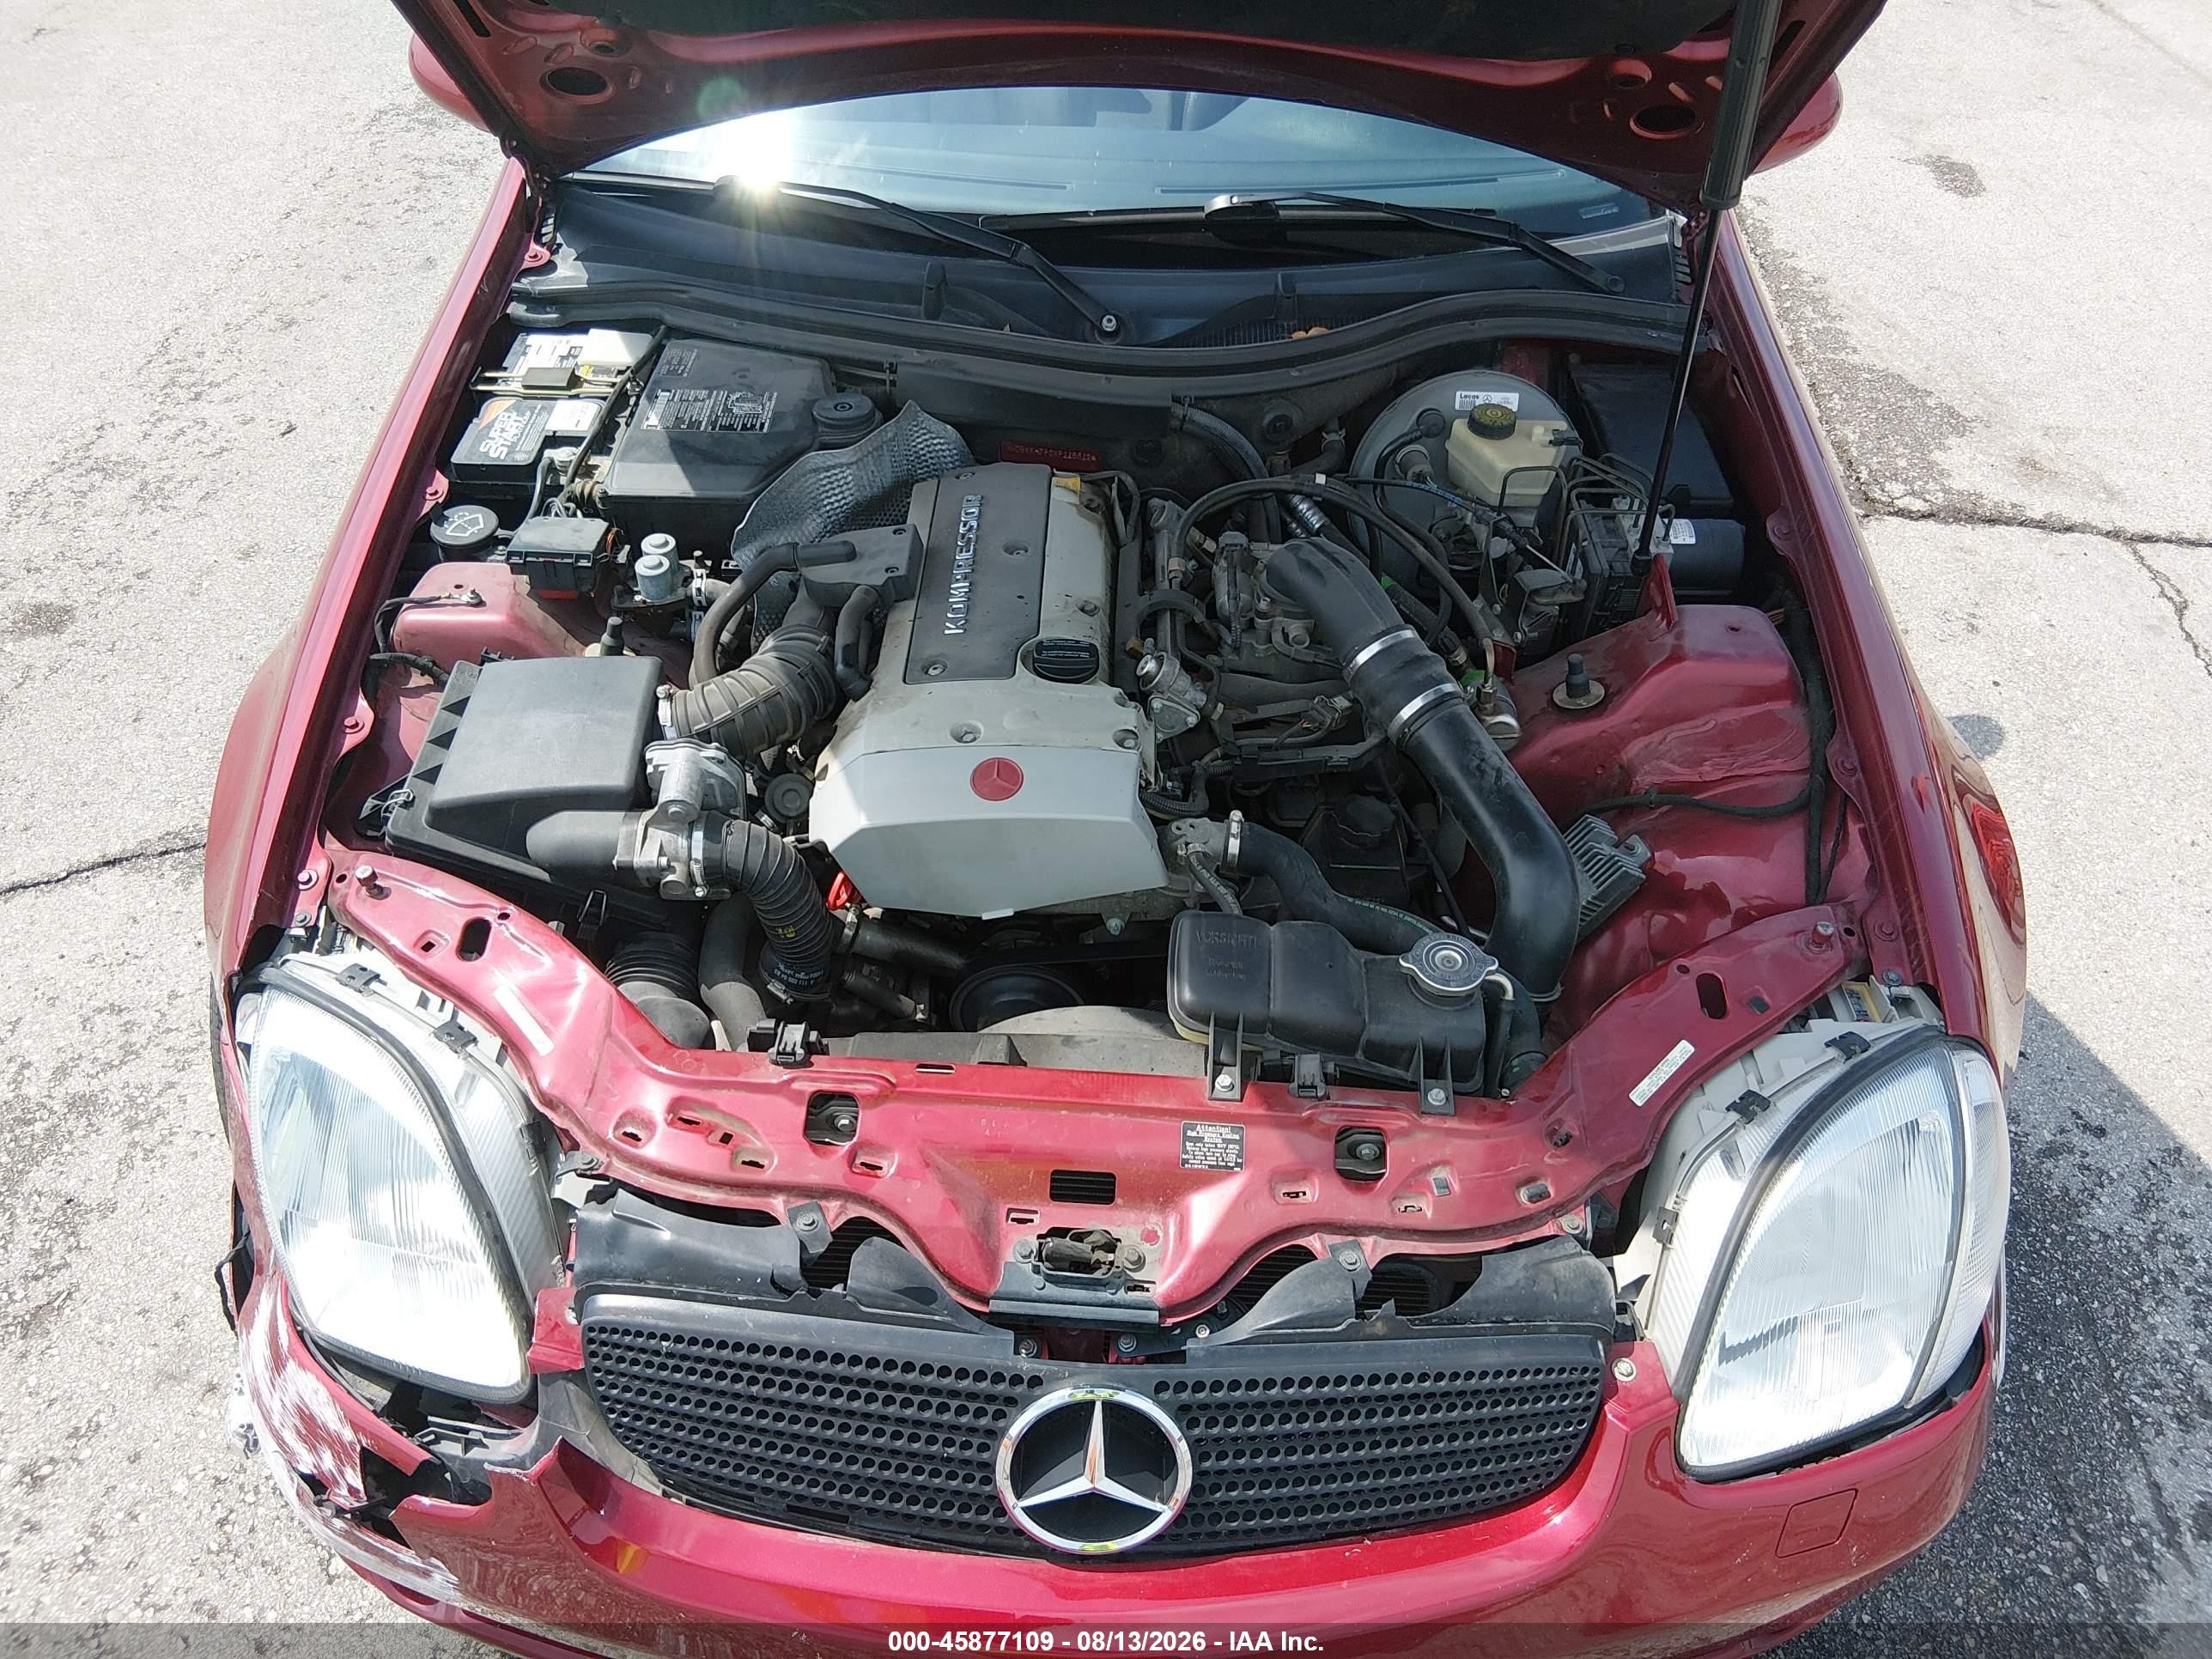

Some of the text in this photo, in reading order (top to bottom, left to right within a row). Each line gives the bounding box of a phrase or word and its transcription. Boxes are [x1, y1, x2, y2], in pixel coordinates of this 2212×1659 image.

[479, 411, 513, 453] SUPER
[488, 410, 520, 460] START
[944, 494, 984, 635] KOMPRESSOR
[1195, 1123, 1231, 1133] Attention!
